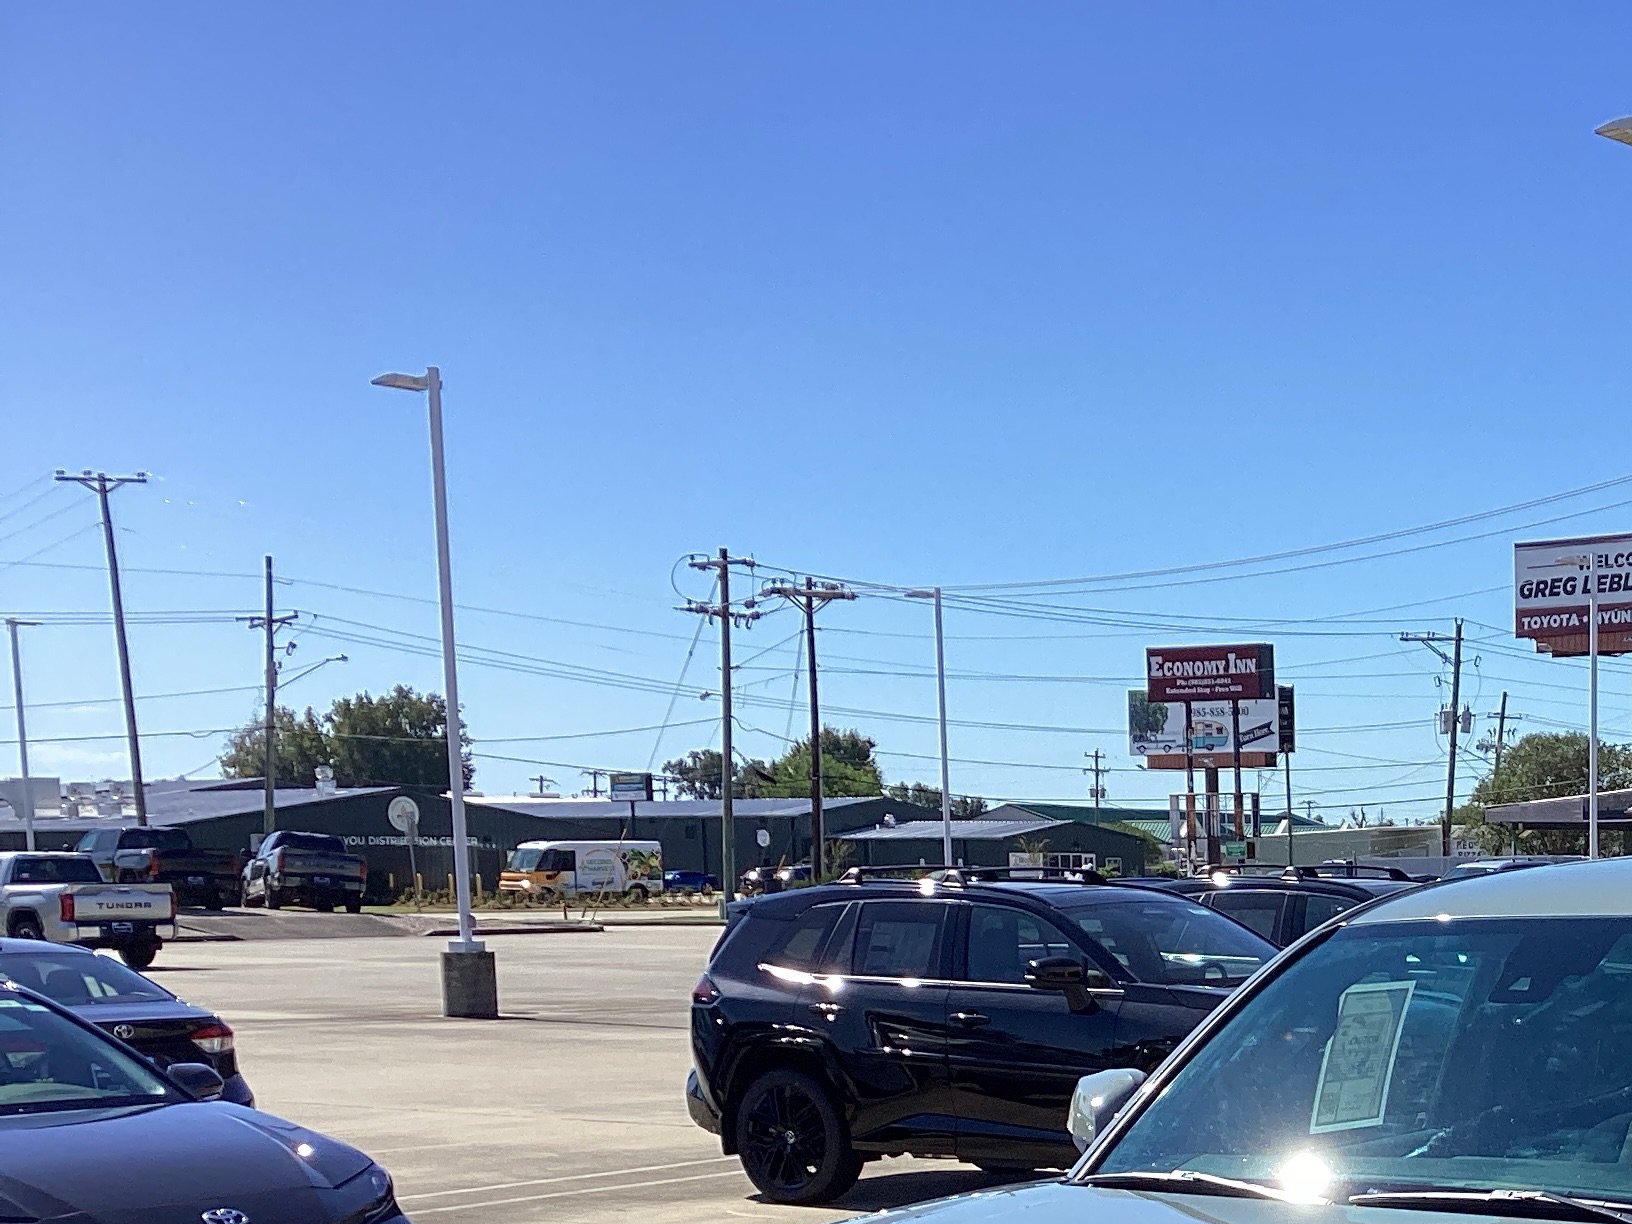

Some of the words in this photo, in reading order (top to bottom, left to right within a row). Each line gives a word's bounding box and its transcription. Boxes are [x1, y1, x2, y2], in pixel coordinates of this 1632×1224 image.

[1520, 576, 1577, 599] GREG
[1522, 613, 1579, 630] TOYOTA
[1150, 656, 1226, 677] ECONOMY
[440, 836, 478, 846] CEER
